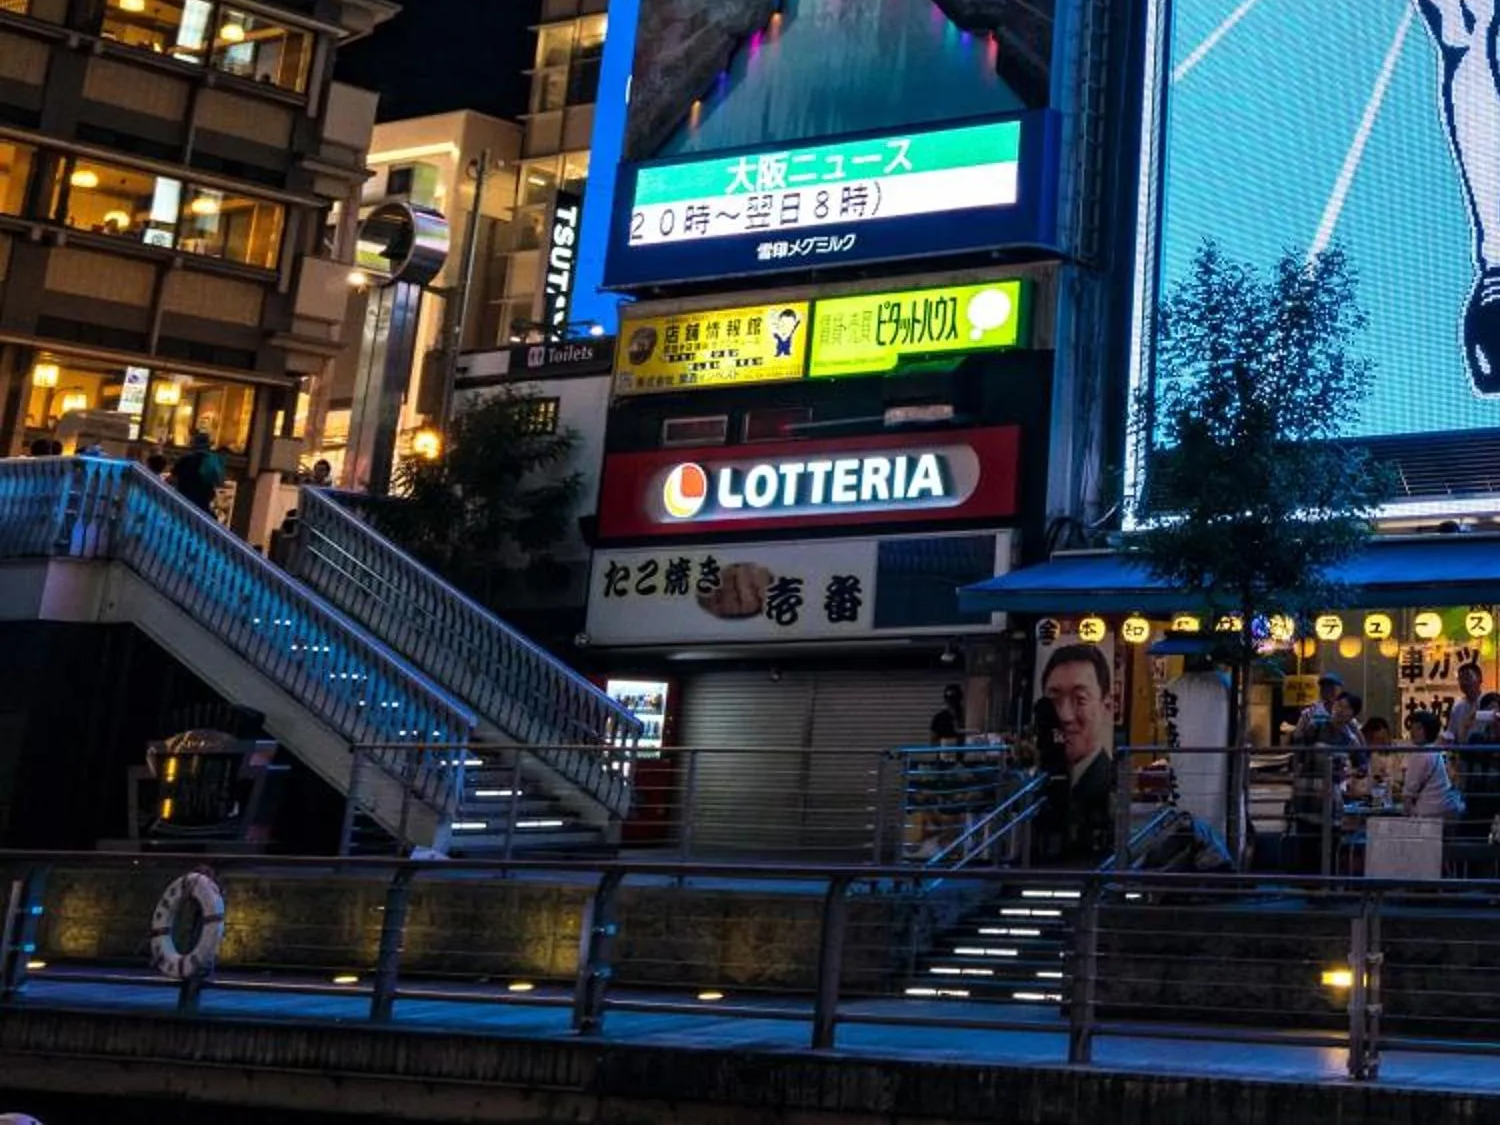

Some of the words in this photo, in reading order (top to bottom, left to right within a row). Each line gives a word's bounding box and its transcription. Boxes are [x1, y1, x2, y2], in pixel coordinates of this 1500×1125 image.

[725, 137, 913, 195] 大阪ニュース
[757, 233, 857, 261] 雪印メグミルク
[546, 205, 578, 343] TSUT
[874, 295, 959, 347] ピタットハウス
[548, 346, 594, 365] Toilets
[717, 453, 945, 509] LOTTERIA
[603, 554, 721, 599] たこ焼き
